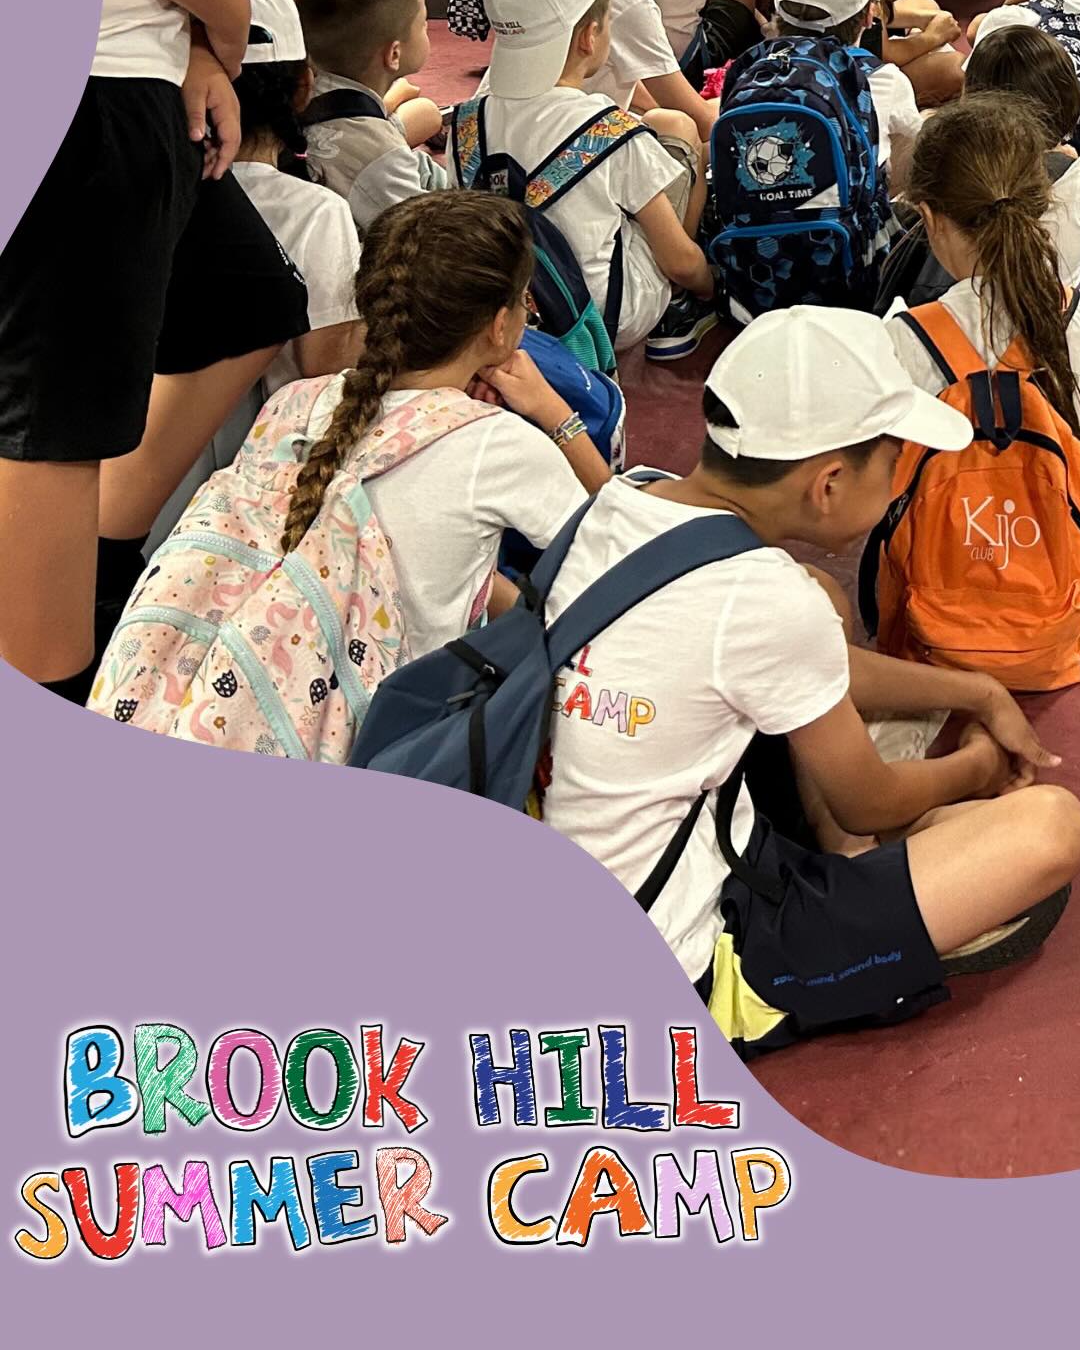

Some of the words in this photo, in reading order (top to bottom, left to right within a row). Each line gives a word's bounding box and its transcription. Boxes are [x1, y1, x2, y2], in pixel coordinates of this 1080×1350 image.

[788, 189, 813, 199] TIME
[961, 496, 1041, 571] Kijo
[970, 546, 995, 561] CLUB
